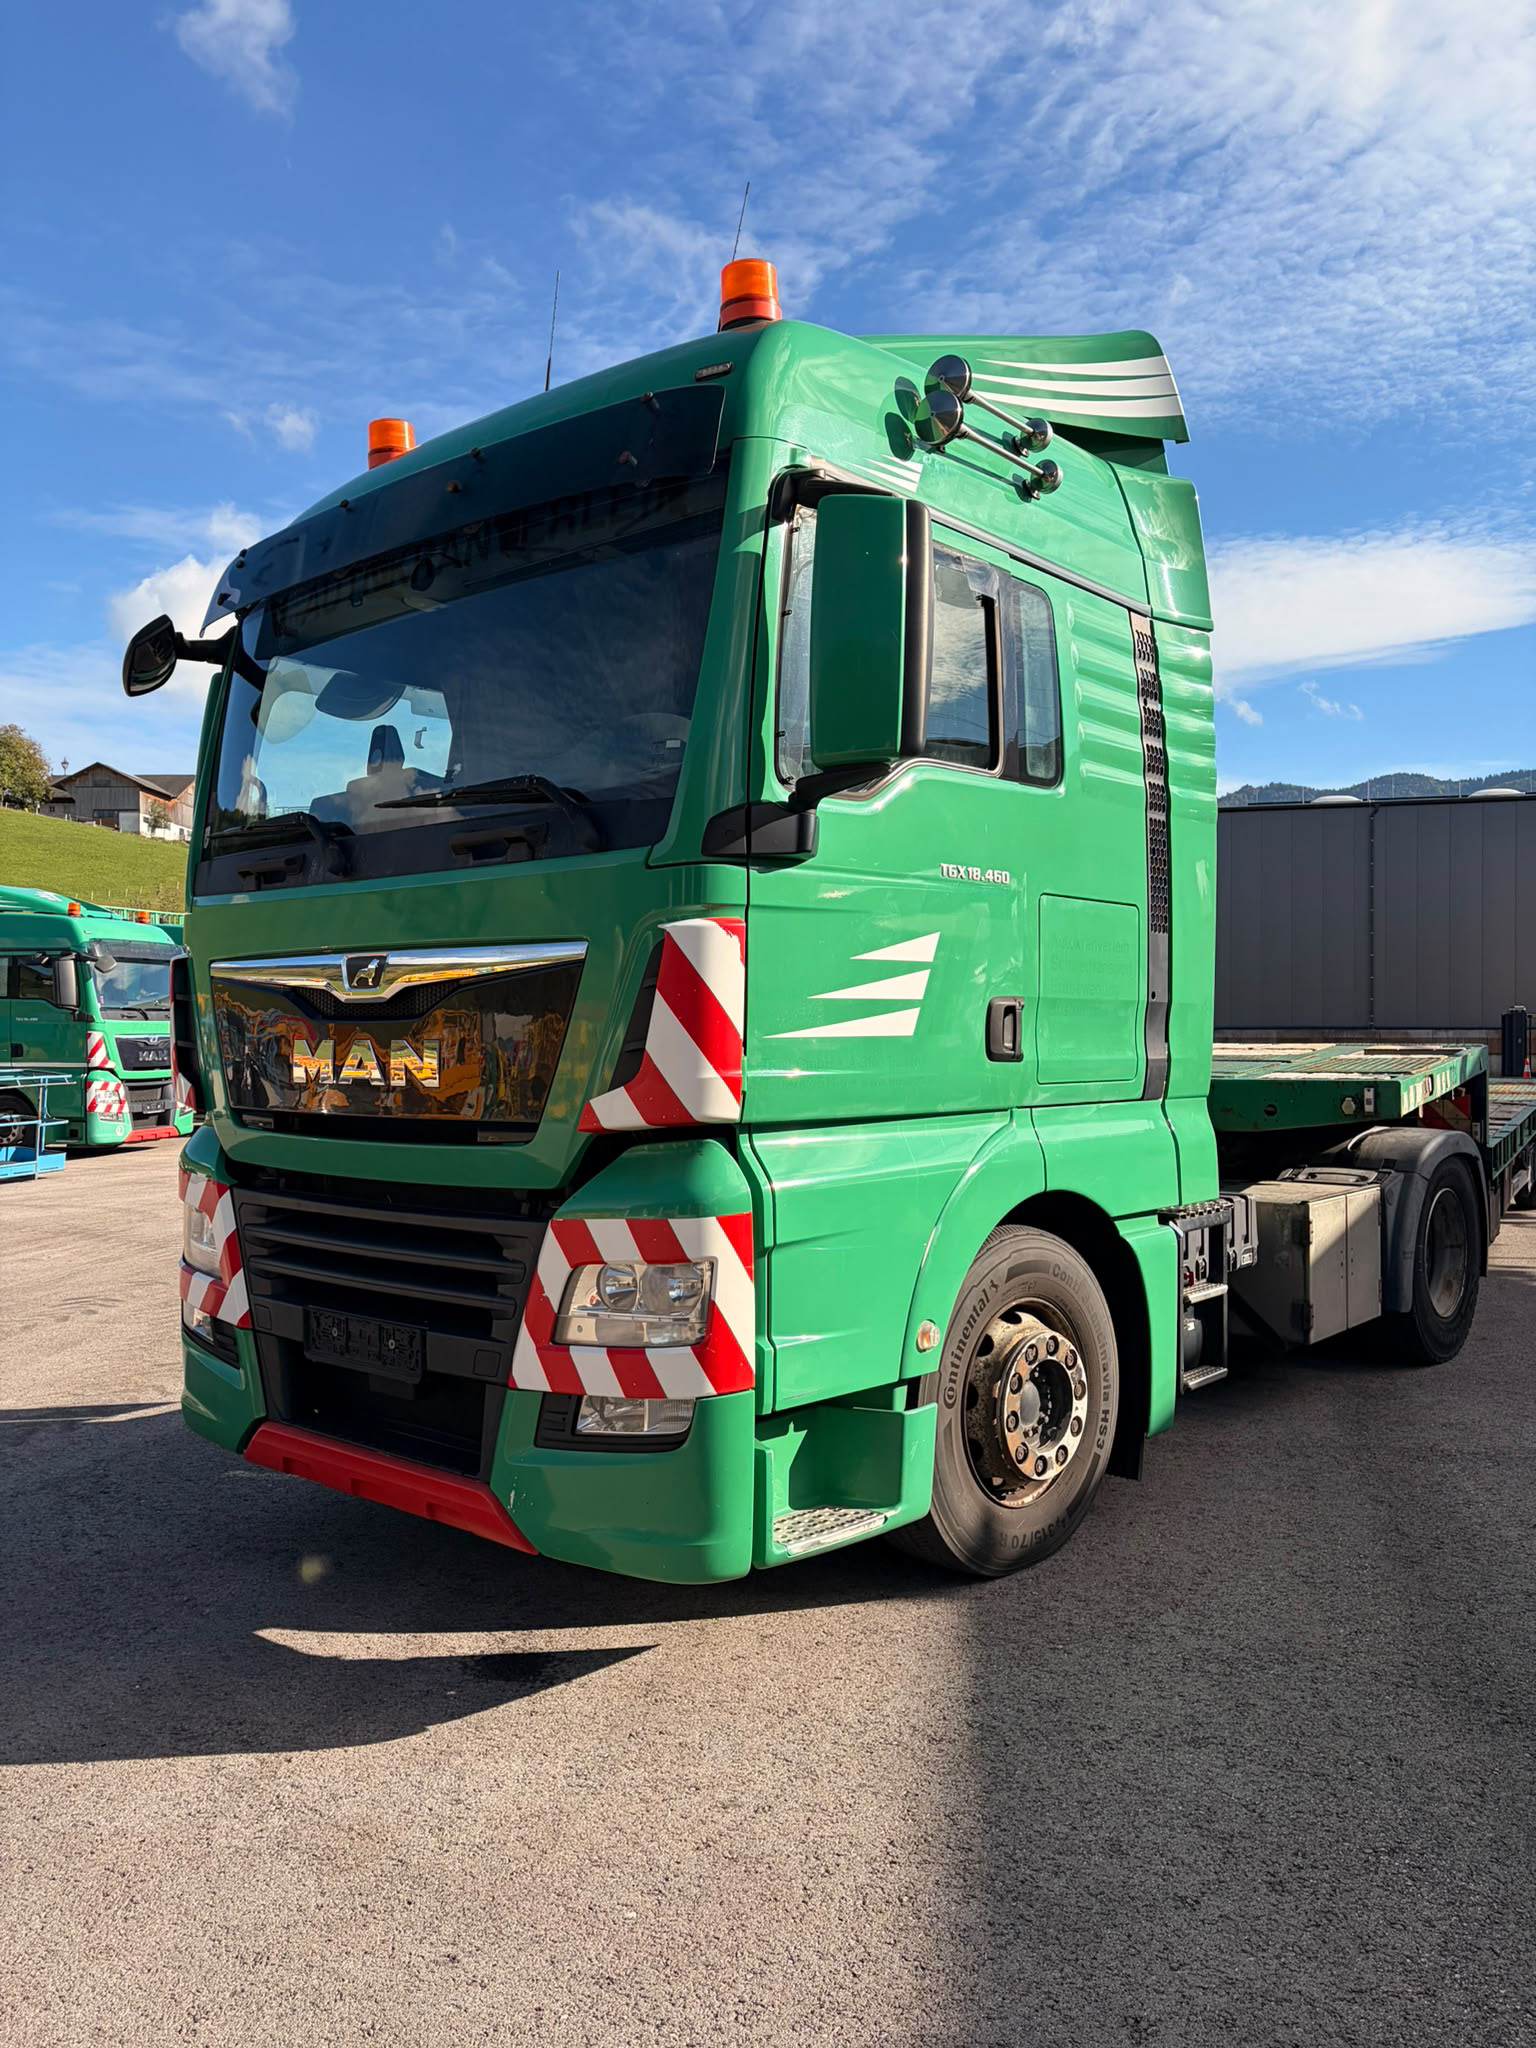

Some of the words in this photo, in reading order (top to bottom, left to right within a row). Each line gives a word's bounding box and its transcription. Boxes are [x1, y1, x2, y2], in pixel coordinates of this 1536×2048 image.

[293, 1039, 441, 1088] MAN
[944, 1291, 991, 1410] Continental
[1096, 1409, 1110, 1450] HS3
